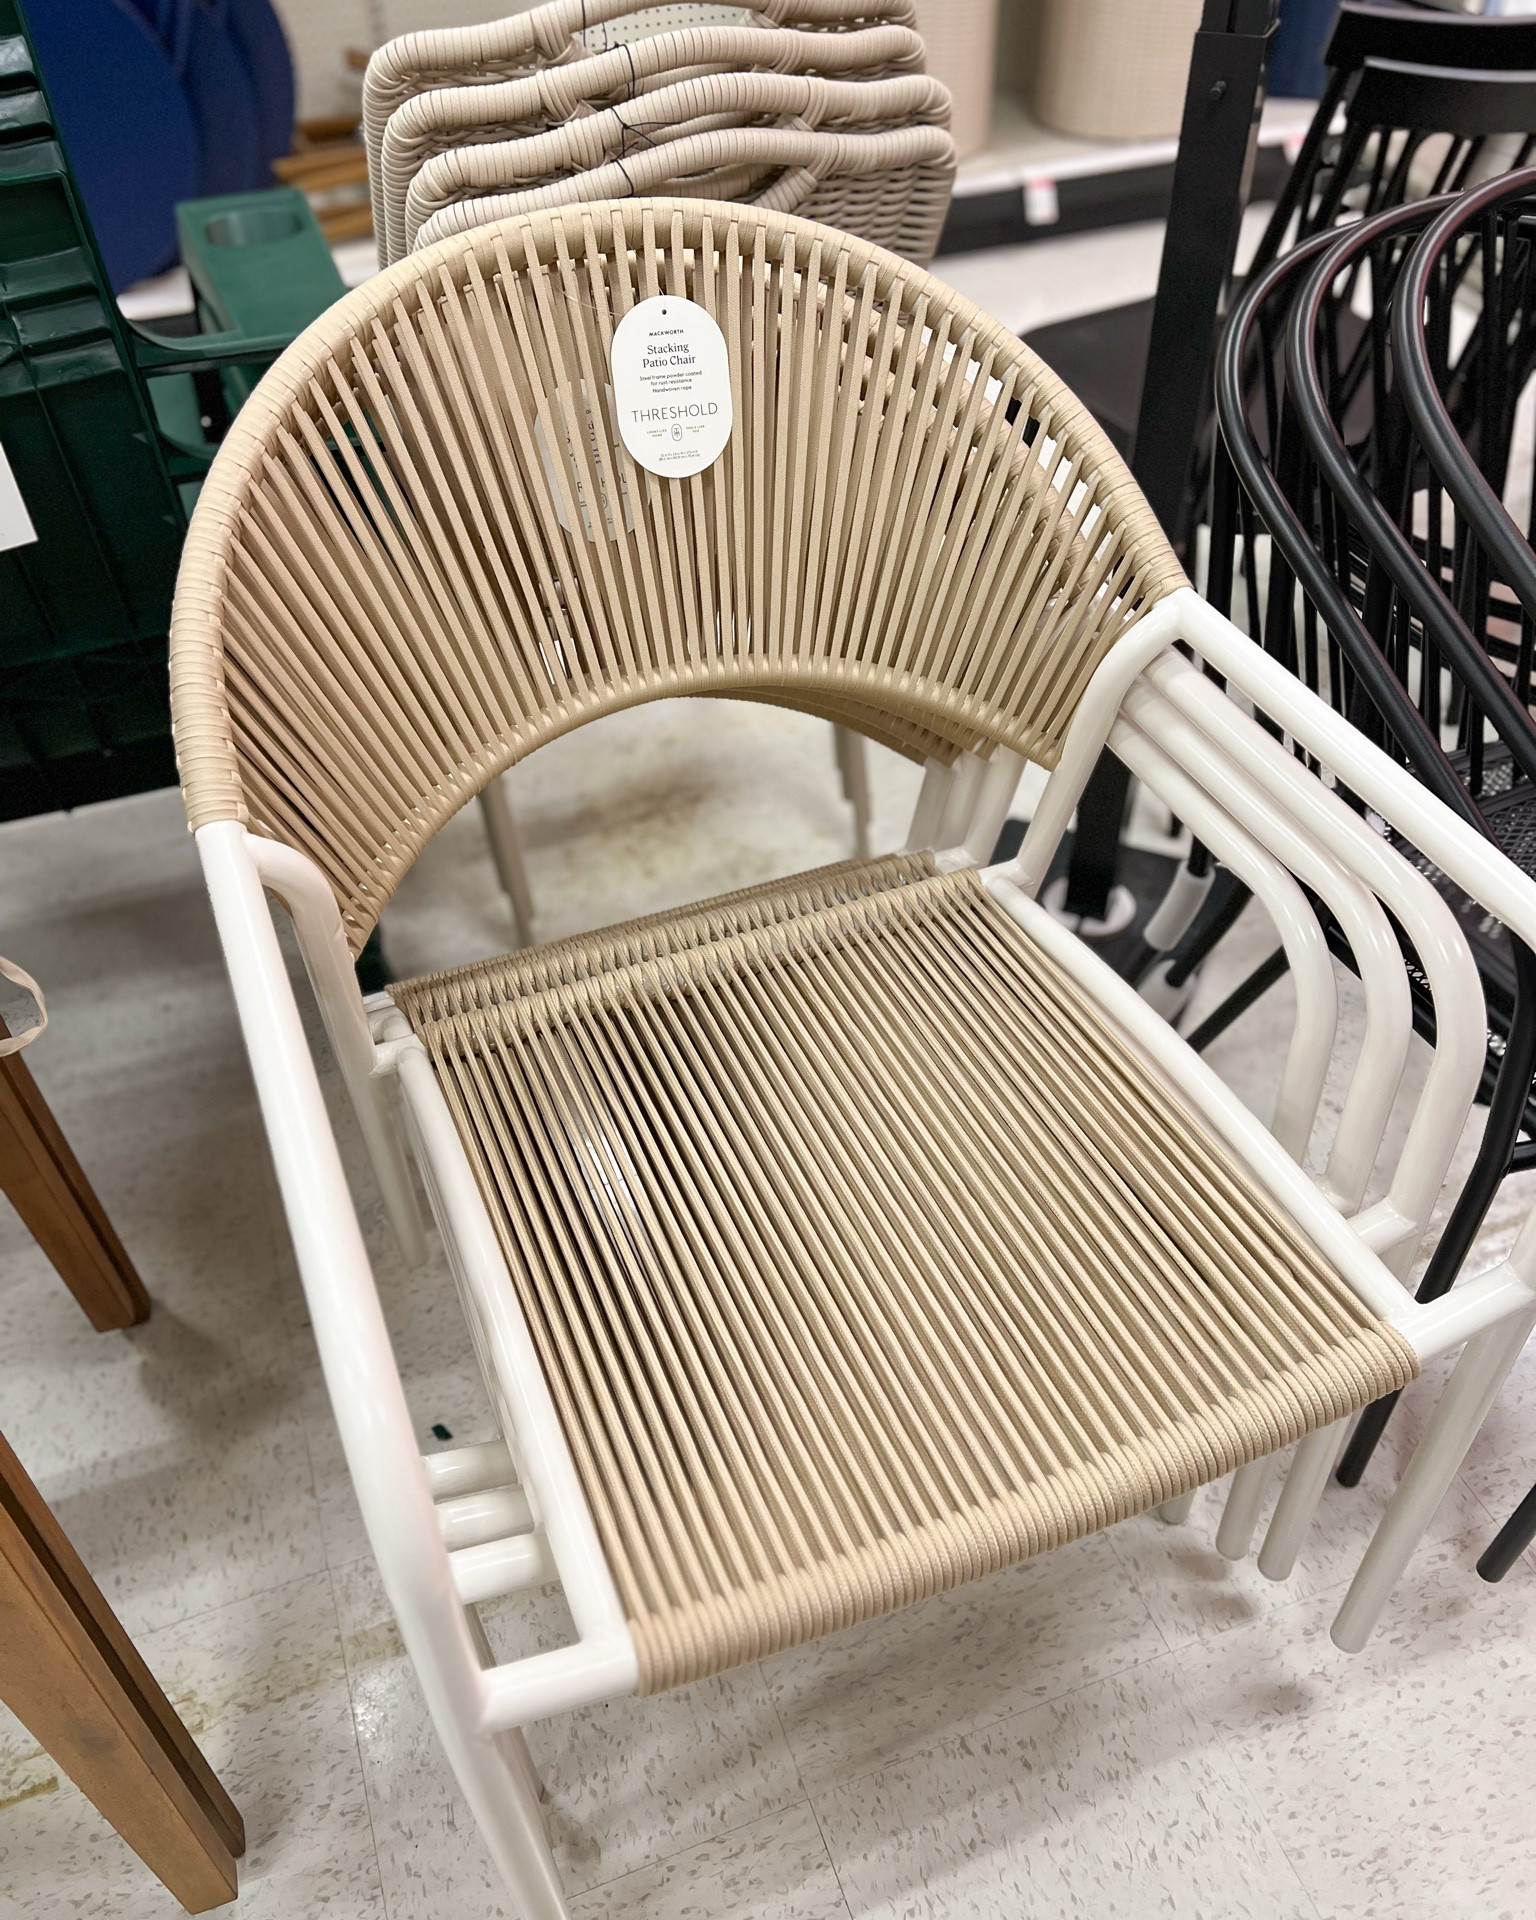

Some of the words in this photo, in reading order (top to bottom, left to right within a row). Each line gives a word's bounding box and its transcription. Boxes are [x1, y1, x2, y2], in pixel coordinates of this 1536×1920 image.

[649, 329, 684, 337] MACKWORTH
[647, 343, 690, 355] Stacking
[642, 358, 668, 368] Patio
[669, 355, 696, 366] Chair
[631, 402, 718, 422] THRESHOLD
